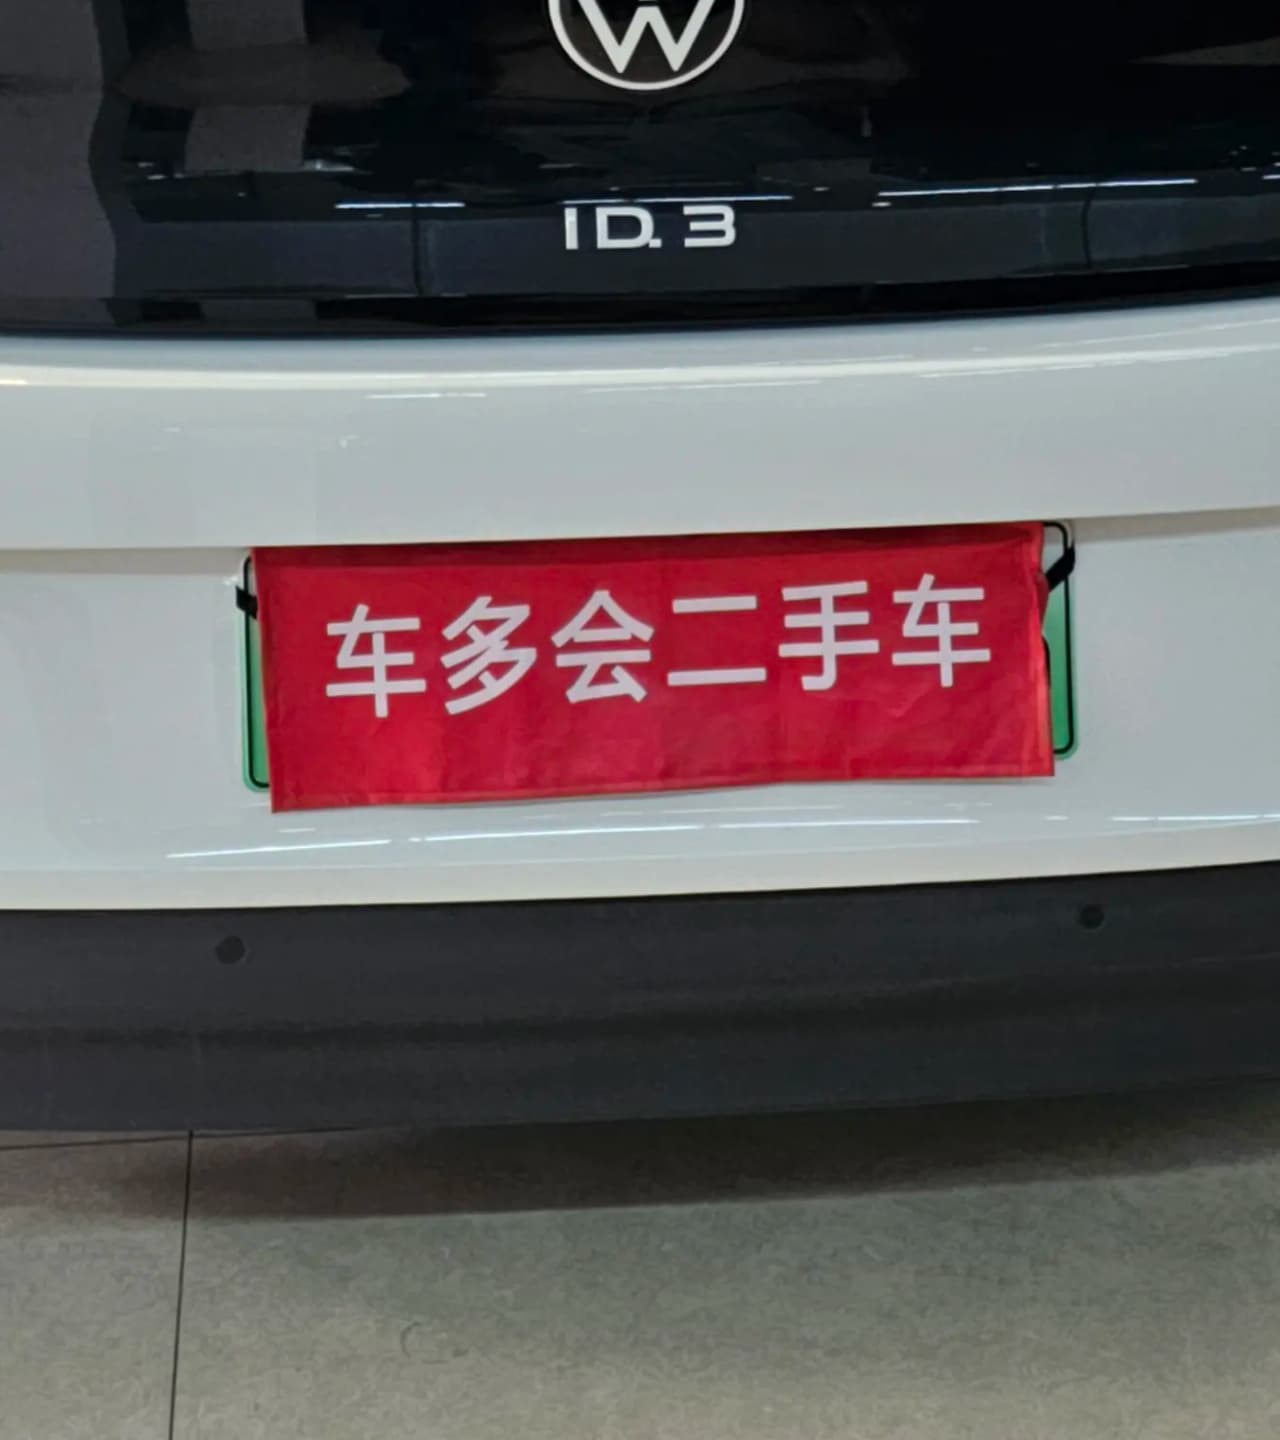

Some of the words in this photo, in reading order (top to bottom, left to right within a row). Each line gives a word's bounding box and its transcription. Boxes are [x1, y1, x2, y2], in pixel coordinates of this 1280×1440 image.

[325, 572, 992, 718] 车多会二手车
